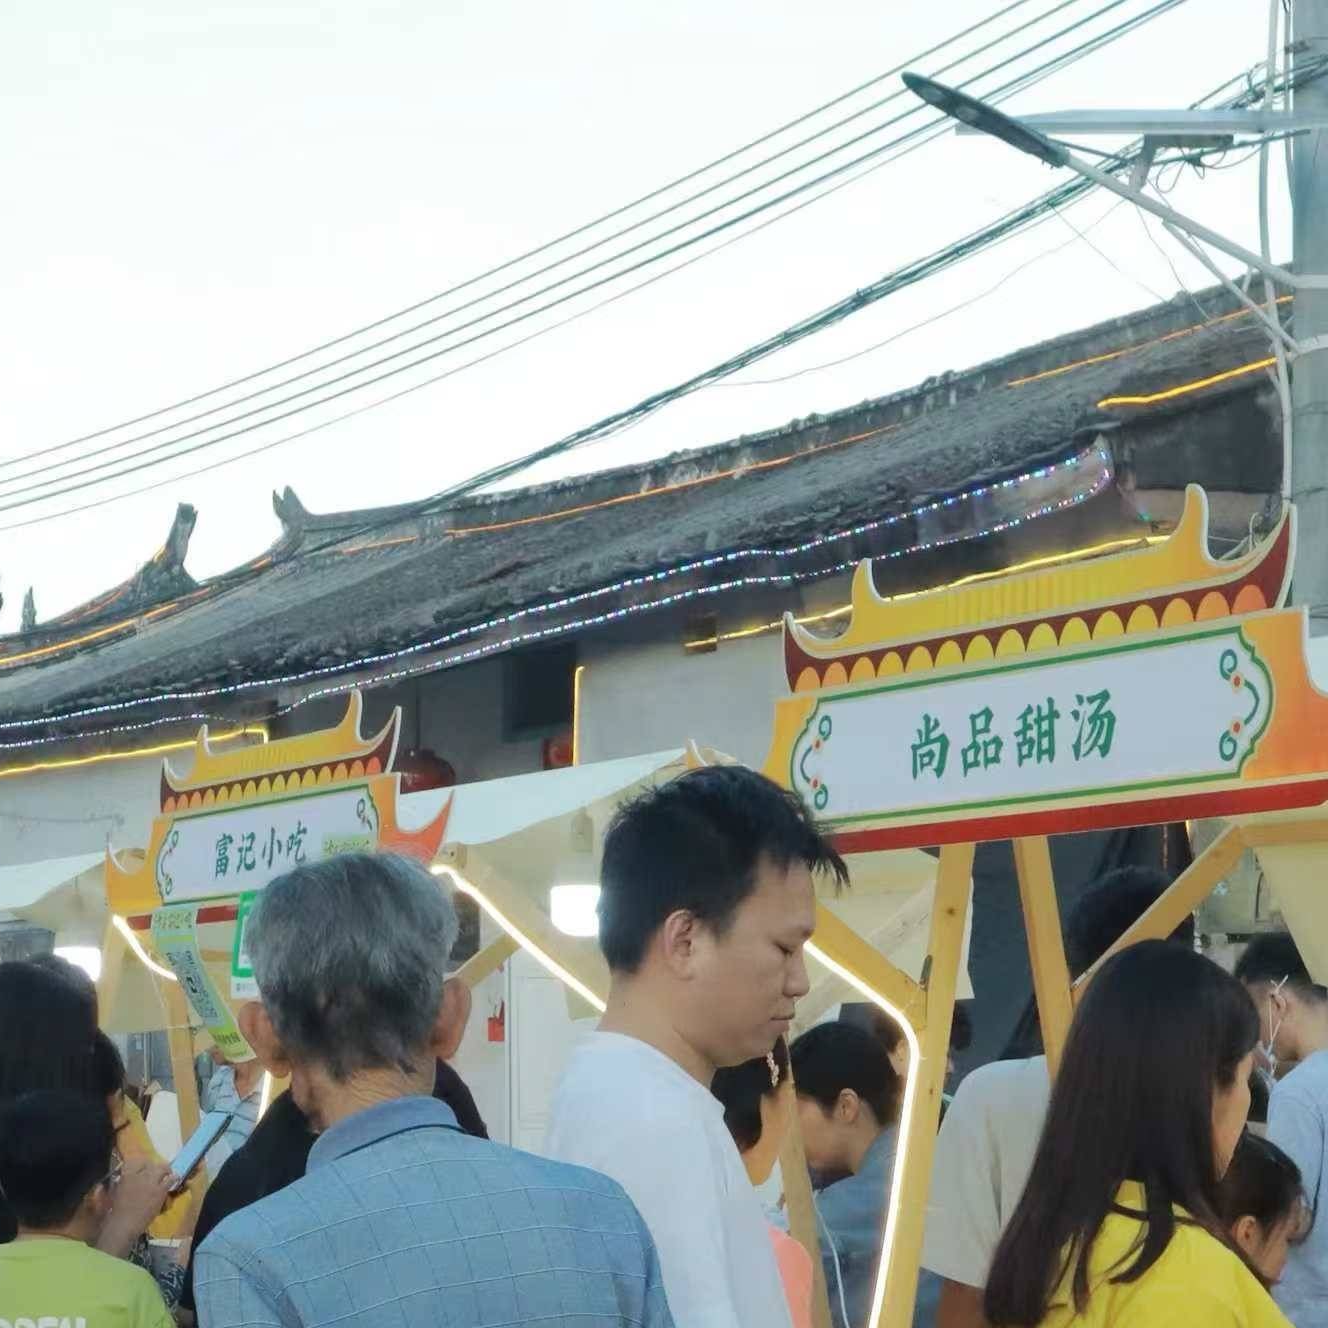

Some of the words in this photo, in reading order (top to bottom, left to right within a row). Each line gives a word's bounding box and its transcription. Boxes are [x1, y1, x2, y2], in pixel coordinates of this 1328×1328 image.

[909, 687, 1118, 780] 尚品甜汤
[215, 819, 308, 879] 富记小吃
